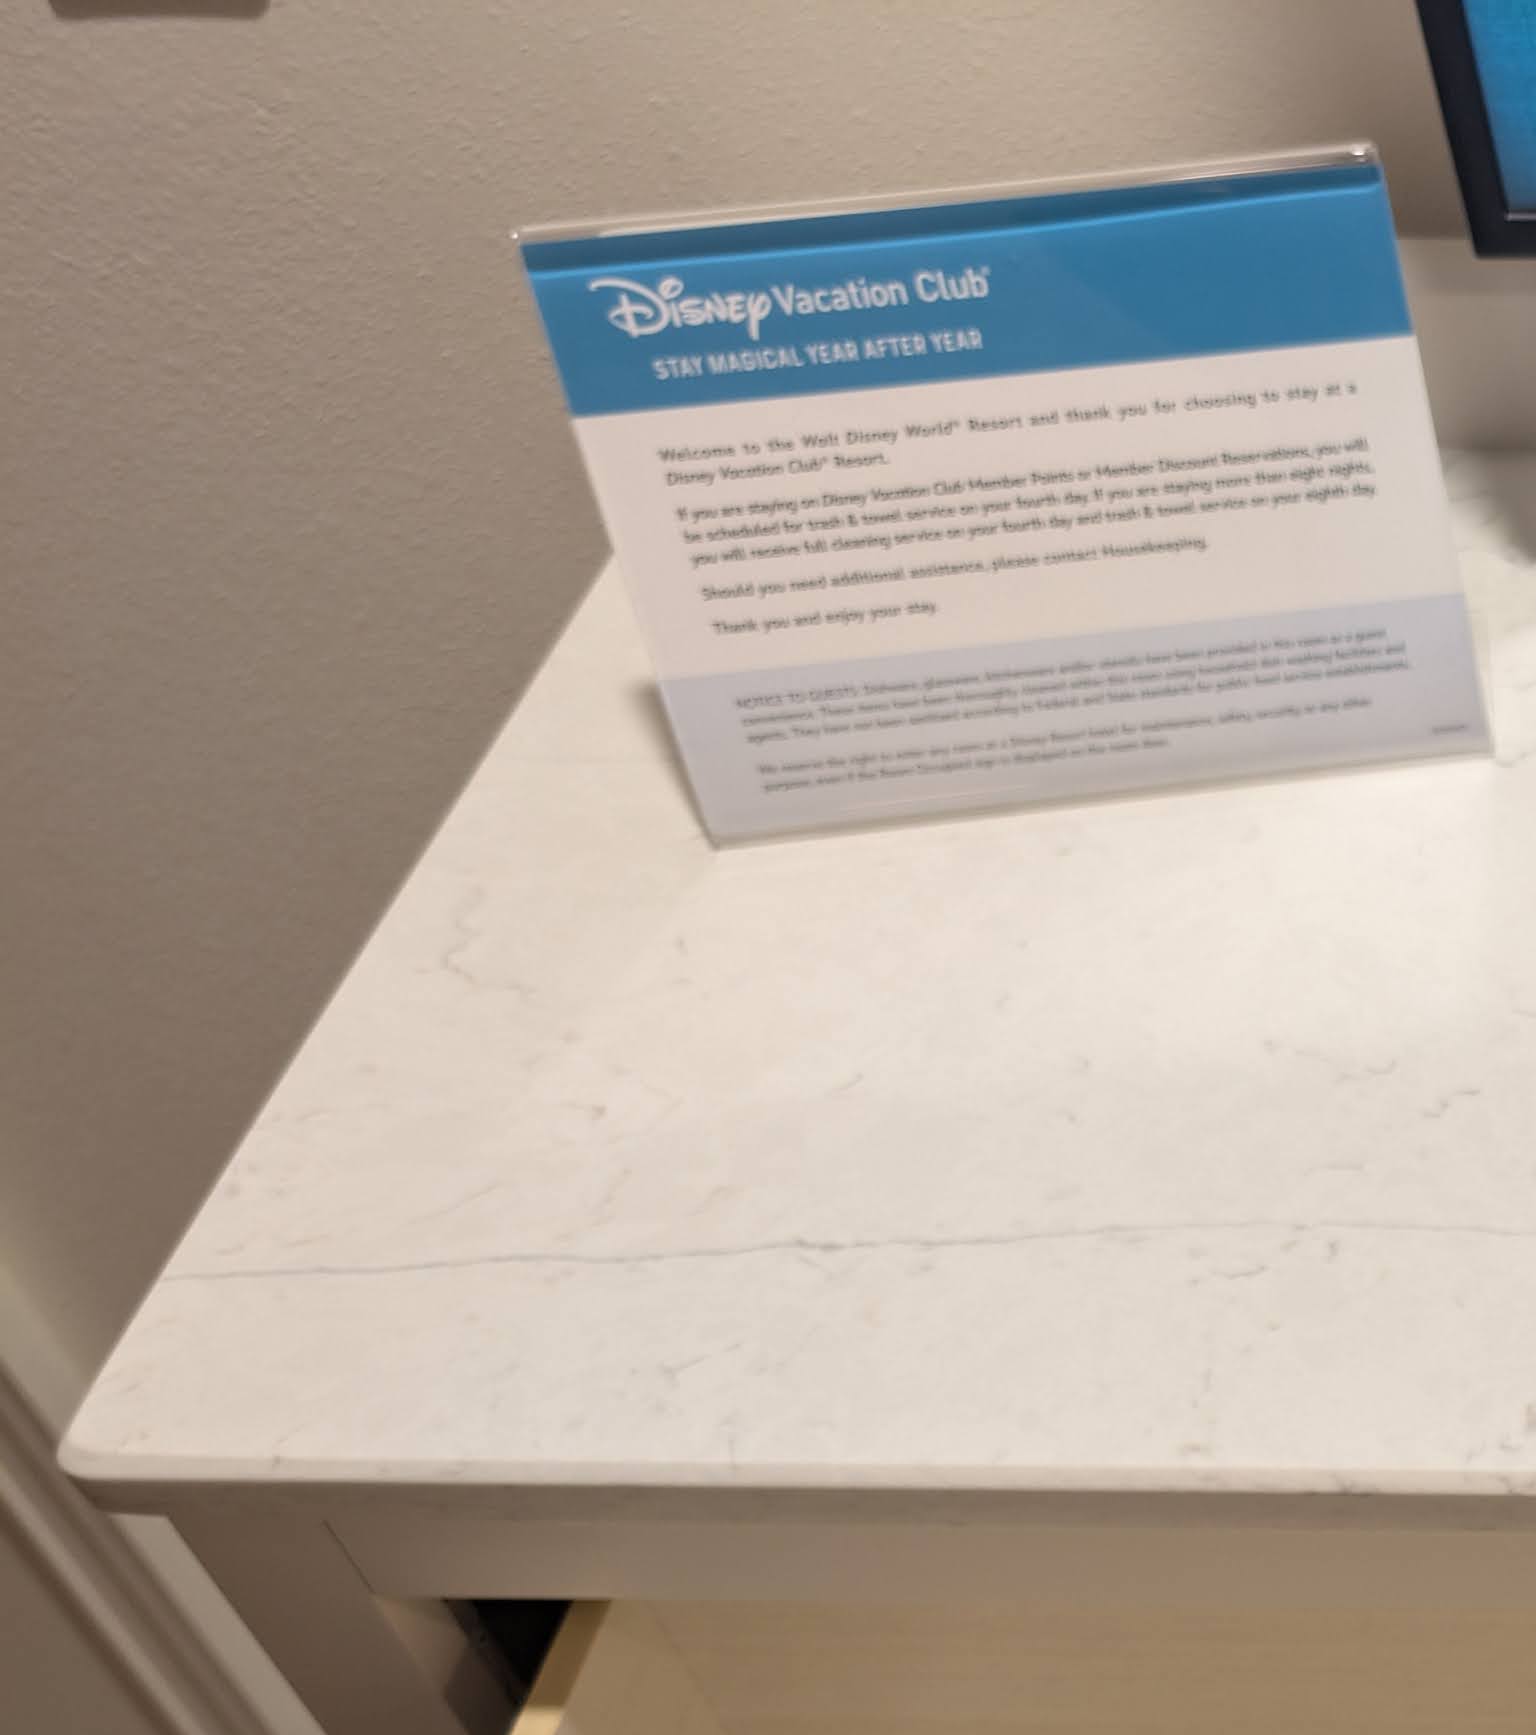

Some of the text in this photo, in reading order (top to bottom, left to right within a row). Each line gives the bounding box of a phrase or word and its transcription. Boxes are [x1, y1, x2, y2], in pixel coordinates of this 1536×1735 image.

[589, 275, 771, 341] Disney
[770, 278, 909, 317] Vacation
[652, 327, 984, 381] STAY MAGICAL YEAR AFTER YEAR
[658, 444, 736, 463] Welcome
[742, 442, 761, 455] to
[766, 438, 795, 452] the
[800, 433, 839, 449] Walt
[845, 427, 899, 448] Disney
[968, 415, 1021, 432] Resort
[1029, 411, 1059, 426] and
[1065, 406, 1110, 422] thank
[1117, 405, 1148, 421] you
[1153, 399, 1176, 413] for
[1183, 391, 1257, 414] choosing
[1263, 390, 1280, 402] to
[1287, 386, 1319, 403] stay
[1325, 383, 1341, 396] at
[1348, 383, 1356, 394] a
[665, 470, 717, 490] Disney
[719, 463, 784, 480] Vacation
[691, 508, 719, 523] you
[721, 505, 742, 517] are
[747, 498, 798, 517] staying
[822, 490, 867, 510] Disney
[871, 483, 930, 501] Vacation
[933, 480, 962, 494] Club
[969, 473, 1027, 490] Member
[1096, 460, 1154, 477] Member
[782, 520, 803, 533] for
[1108, 488, 1133, 503] you
[690, 554, 720, 569] you
[803, 539, 828, 553] full
[701, 584, 755, 600] Should
[756, 584, 787, 598] you
[991, 554, 1039, 573] please
[713, 620, 758, 635] Thank
[763, 620, 792, 634] you
[793, 613, 822, 627] and
[825, 609, 868, 627] enjoy
[869, 608, 903, 622] your
